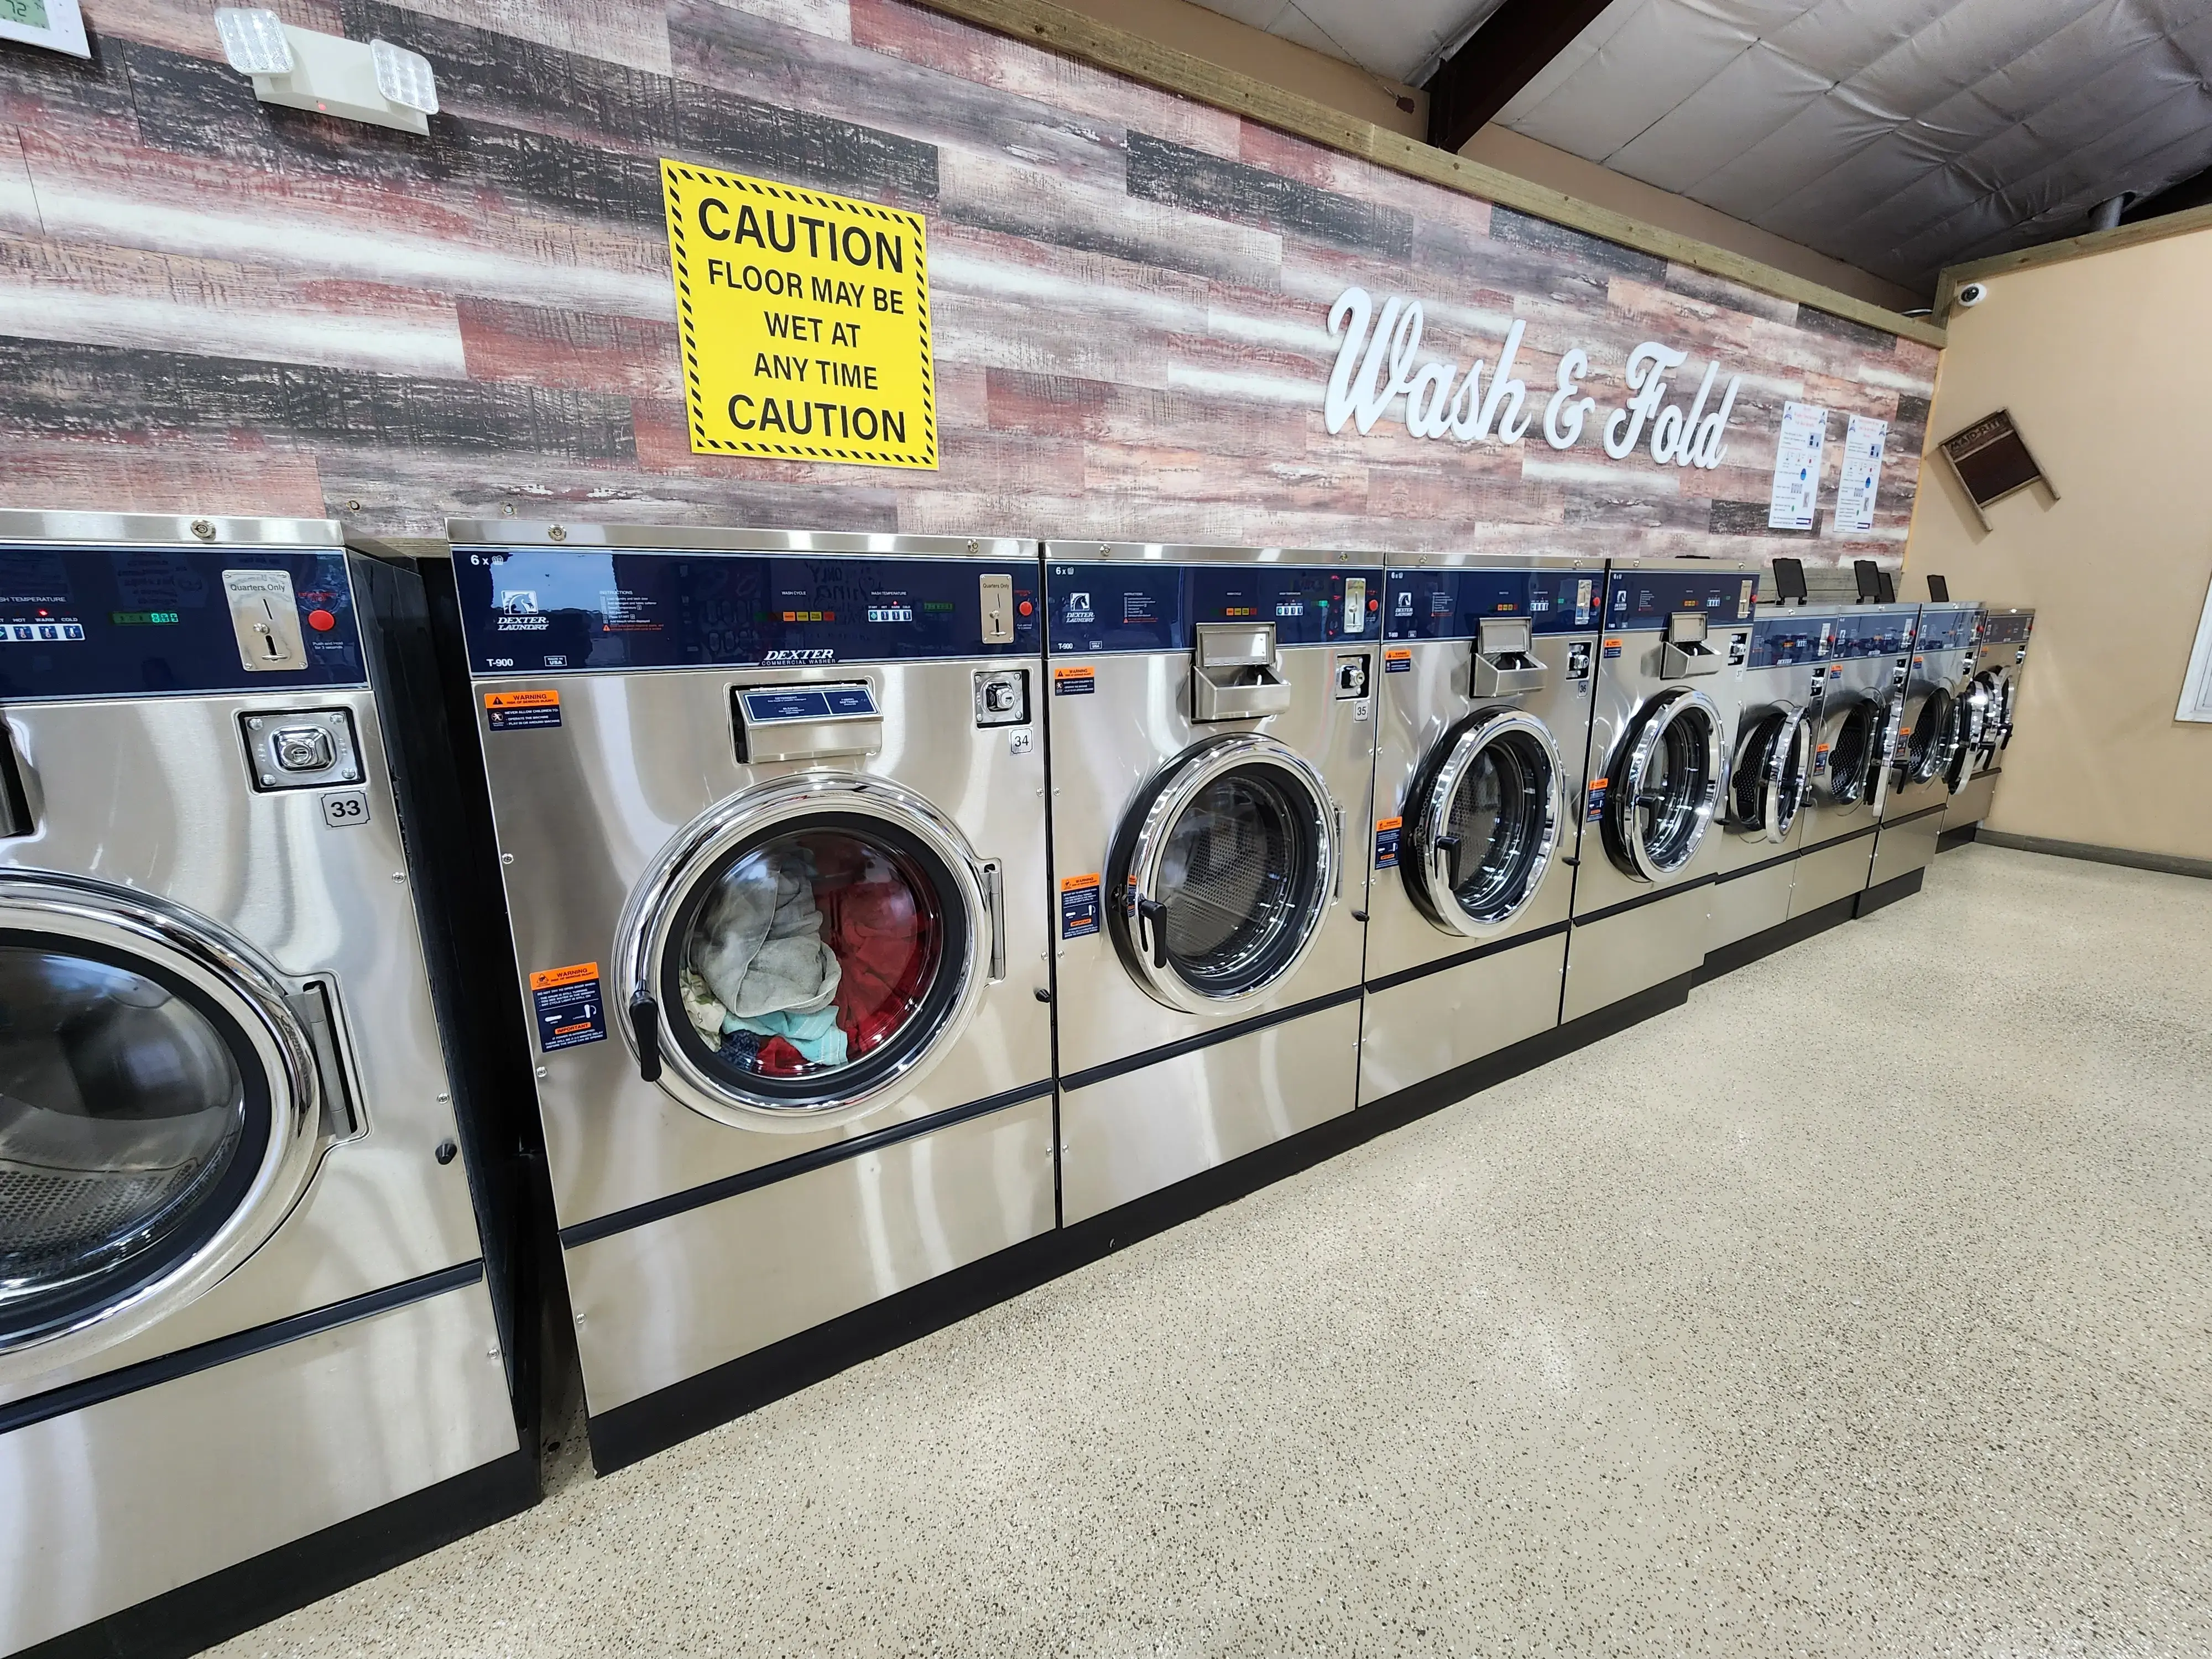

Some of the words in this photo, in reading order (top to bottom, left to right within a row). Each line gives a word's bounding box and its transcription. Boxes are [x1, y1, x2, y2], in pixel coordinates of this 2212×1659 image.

[698, 197, 904, 274] CAUTION
[707, 258, 803, 299] FLOOR
[811, 276, 865, 309] MAY
[874, 288, 904, 315] BE
[764, 311, 823, 342] WET
[831, 321, 861, 348] AT
[754, 352, 808, 382] ANY
[816, 359, 878, 390] TIME
[1324, 286, 1532, 445] Wash
[1543, 348, 1596, 450] &
[1604, 341, 1742, 470] Fold
[728, 394, 906, 444] CAUTION
[471, 554, 480, 565] 6
[1056, 566, 1062, 575] 6
[267, 584, 285, 592] Only
[763, 649, 834, 661] DEXTER
[486, 658, 514, 667] T-900
[1579, 685, 1587, 693] 36
[1357, 706, 1366, 716] 35
[1014, 734, 1029, 747] 34
[330, 800, 361, 818] 33
[556, 968, 588, 978] WARNING
[557, 1023, 588, 1033] IMPORTANT
